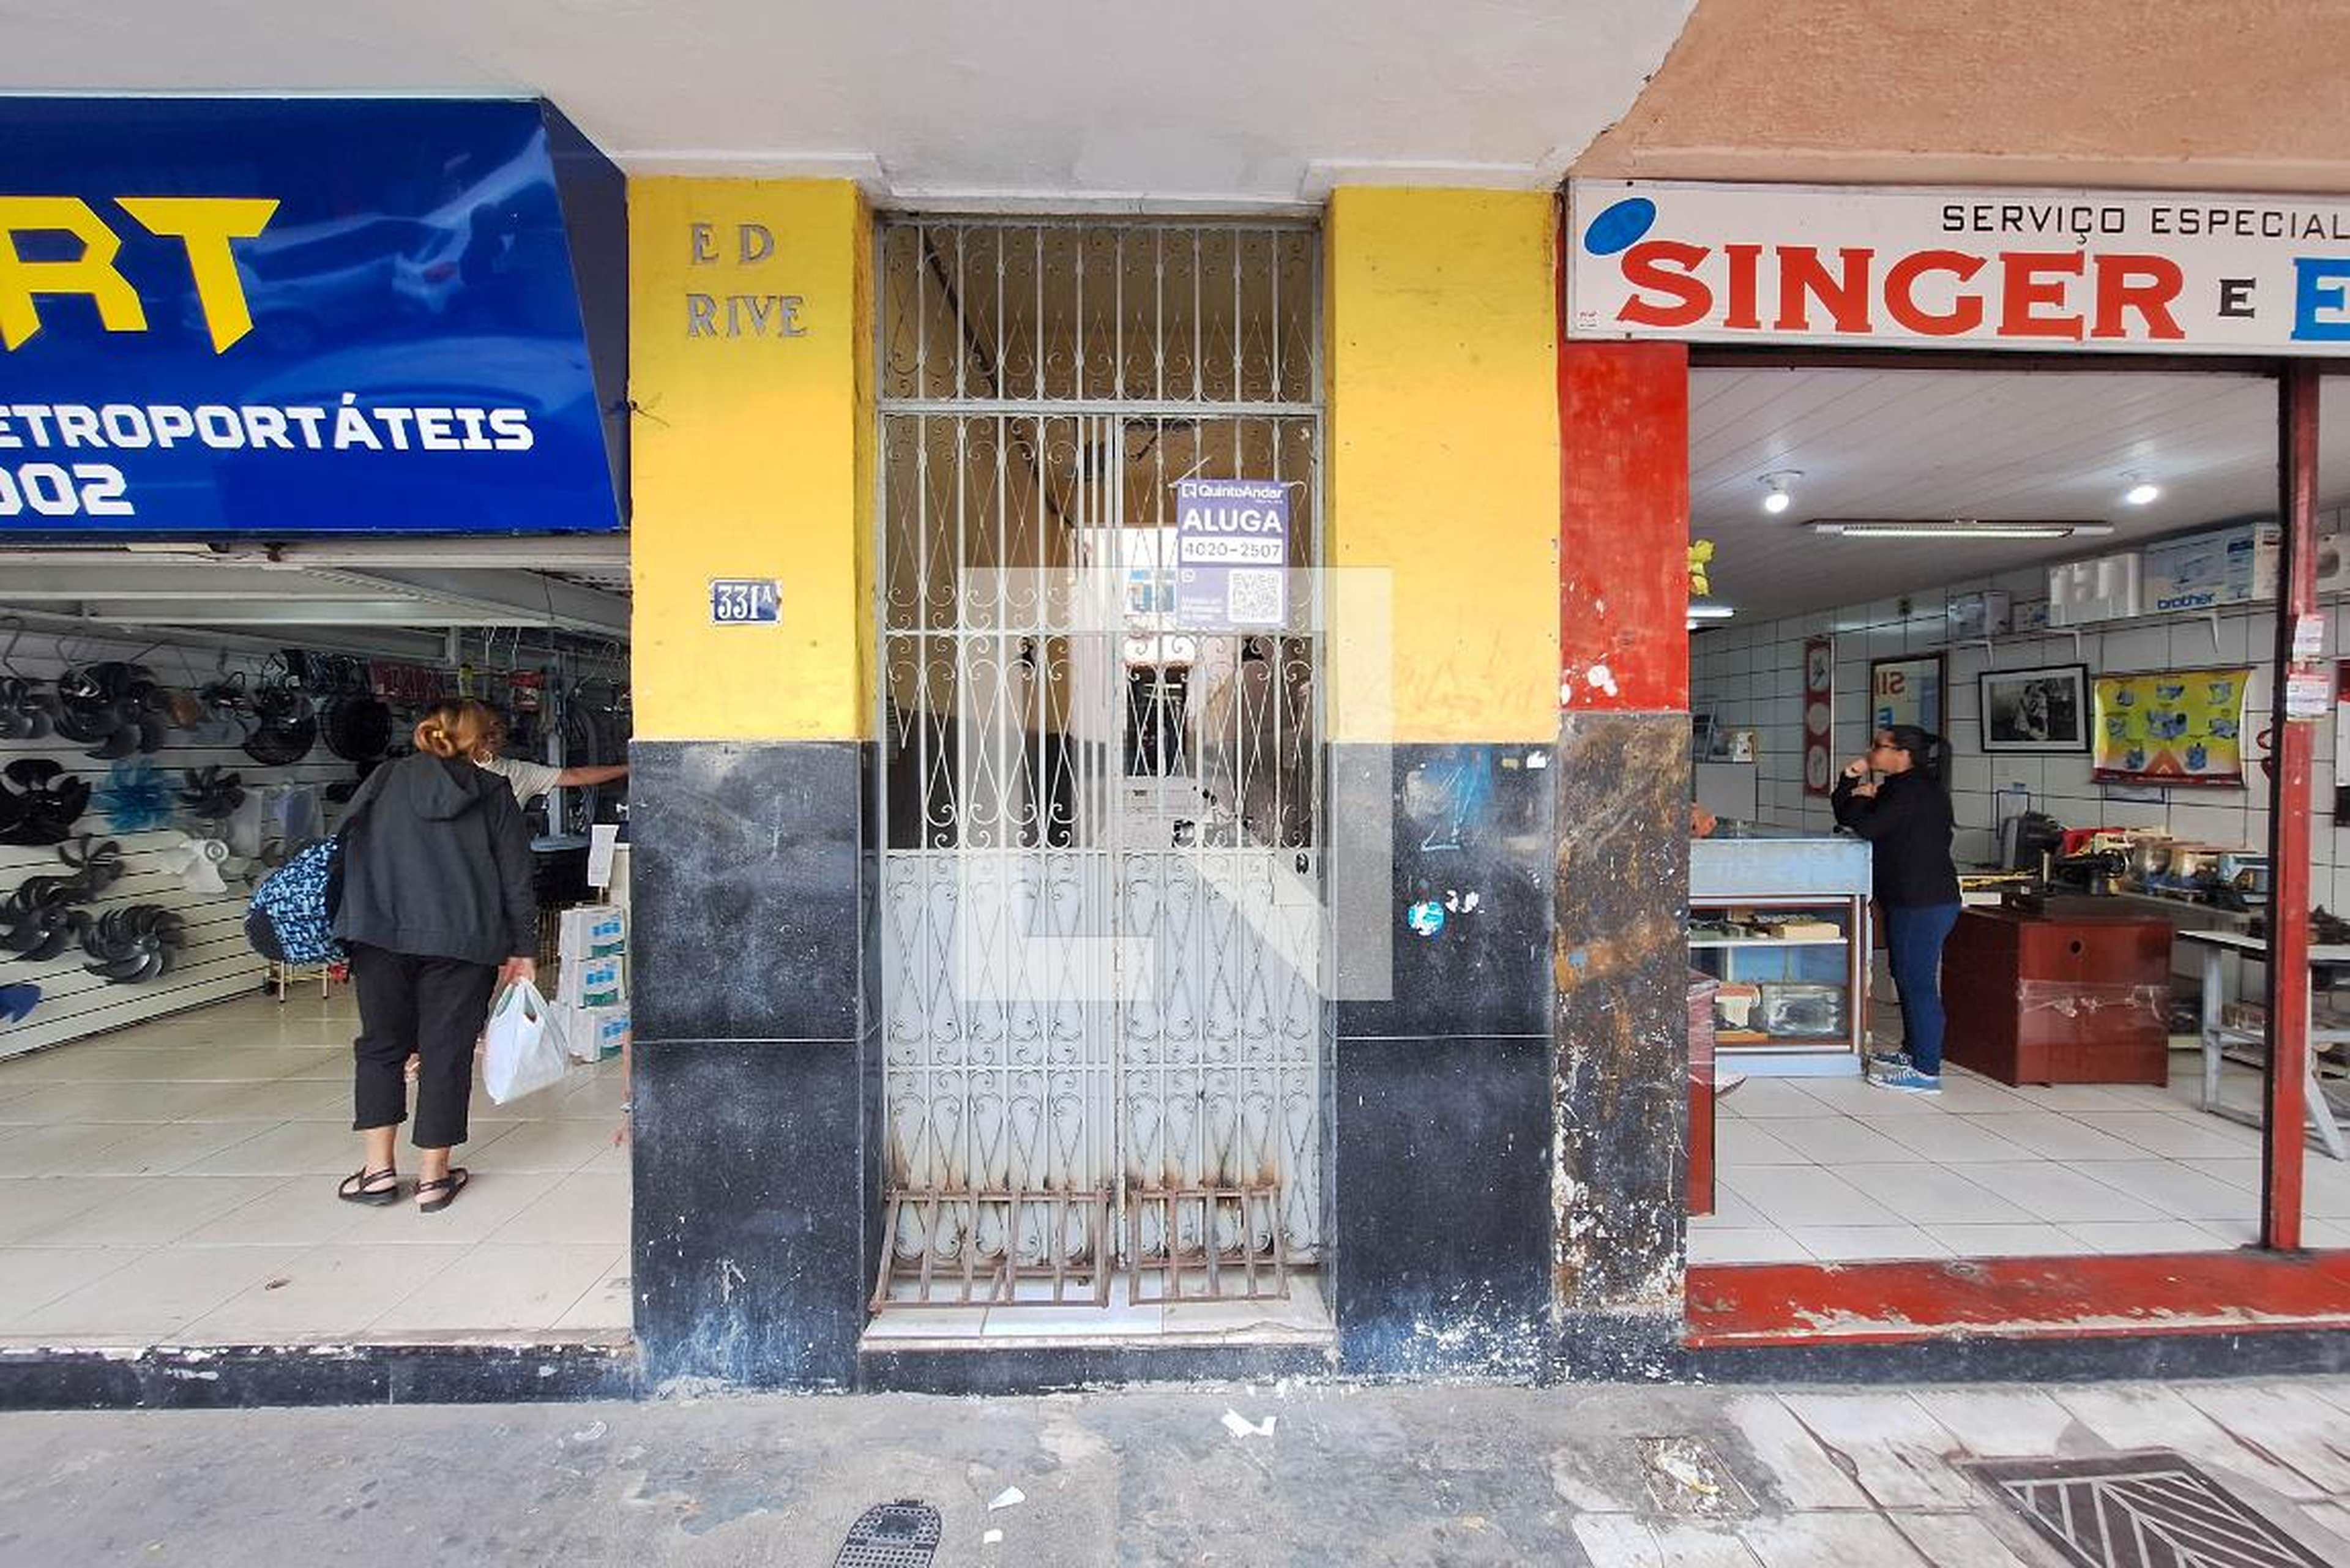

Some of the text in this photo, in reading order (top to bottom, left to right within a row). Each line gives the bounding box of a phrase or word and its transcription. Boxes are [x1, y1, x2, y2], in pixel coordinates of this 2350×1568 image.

[1942, 205, 2350, 245] SERVIÇO ESPECIAL
[0, 196, 280, 354] RT
[1616, 239, 2350, 341] SINGER E E
[685, 293, 809, 338] RIVE
[1198, 483, 1283, 499] QuintoAndar
[1182, 508, 1283, 532] ALUGA
[1185, 542, 1281, 558] 4020-2507
